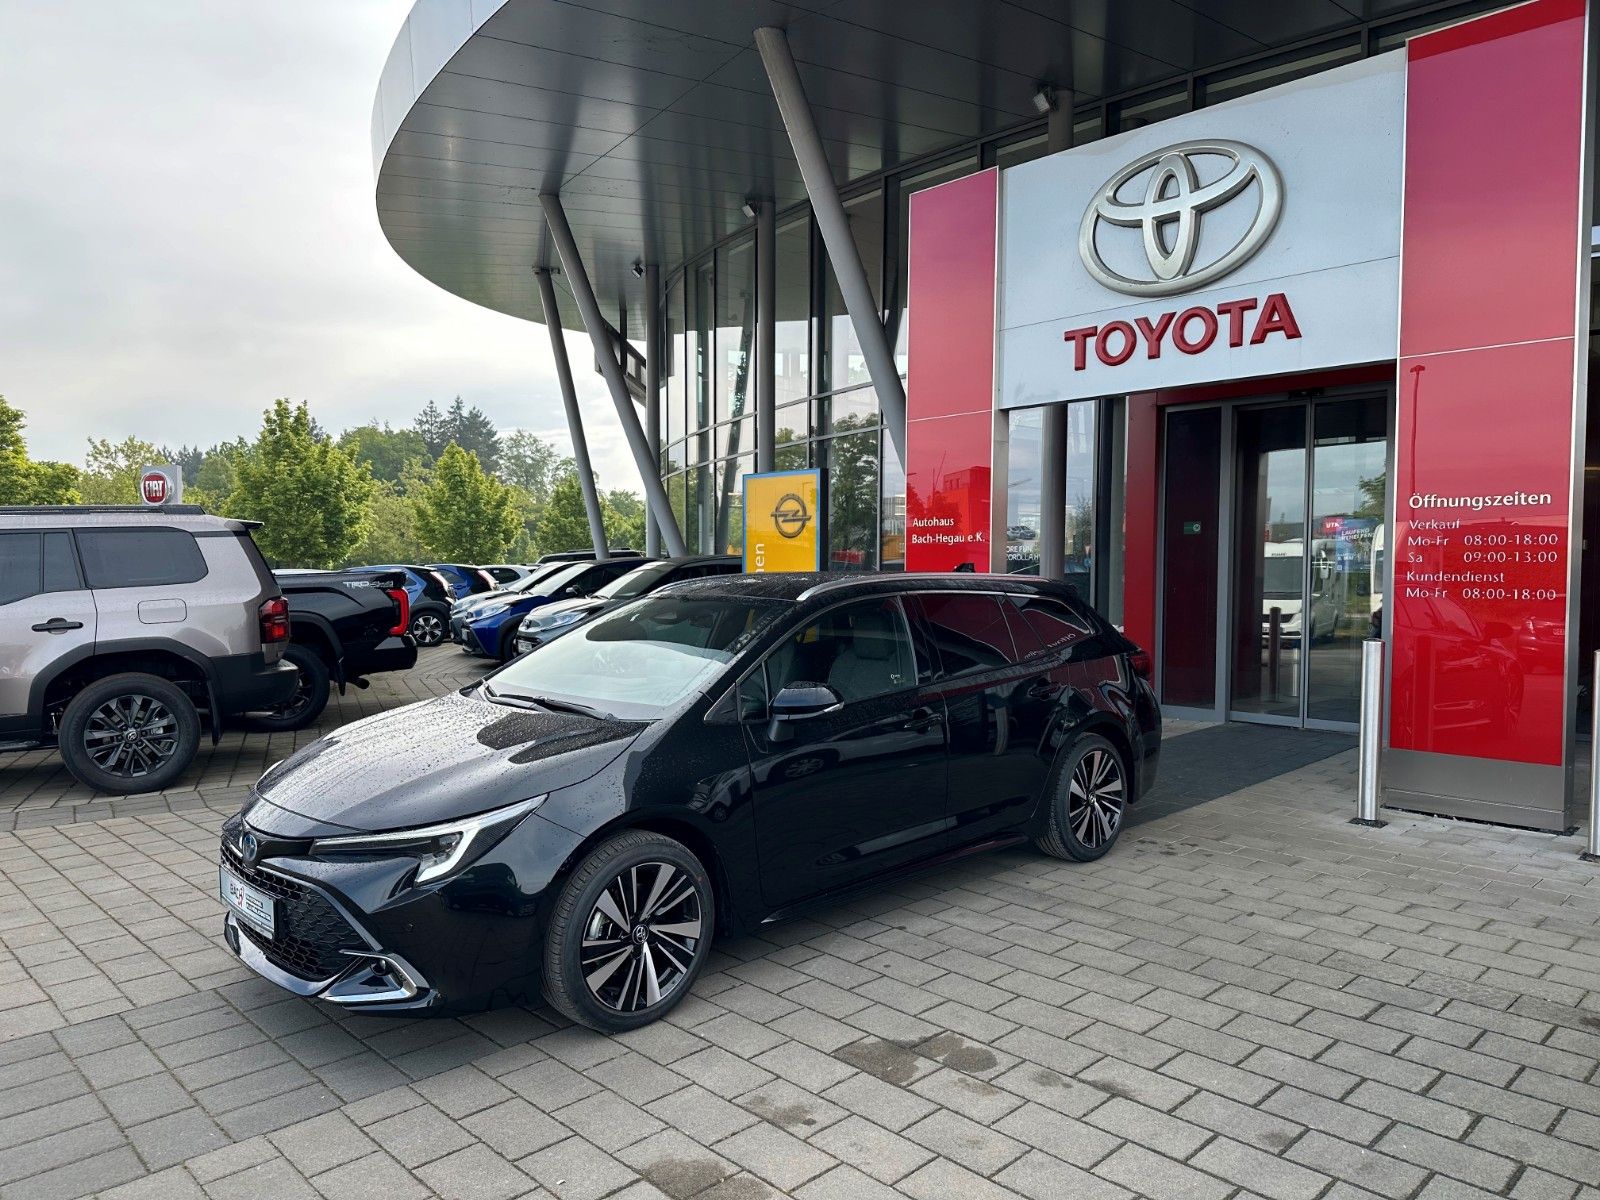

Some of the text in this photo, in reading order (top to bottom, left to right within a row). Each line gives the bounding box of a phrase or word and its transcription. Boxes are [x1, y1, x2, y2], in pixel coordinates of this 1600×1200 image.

[1064, 293, 1301, 370] TOYOTA
[145, 480, 164, 497] FIAT
[1408, 491, 1551, 510] Öffnungszeiten
[912, 517, 954, 527] Autohaus
[1409, 518, 1460, 530] Verkauf
[911, 532, 985, 546] Bach-Hegau e.K.
[1407, 533, 1558, 546] Mo-Fr 08:00-18:00
[1407, 551, 1558, 563] Sa 09:00-13:00
[1406, 570, 1505, 583] Kundendienst
[1405, 587, 1557, 600] Mo-Fr 08:00-18:00
